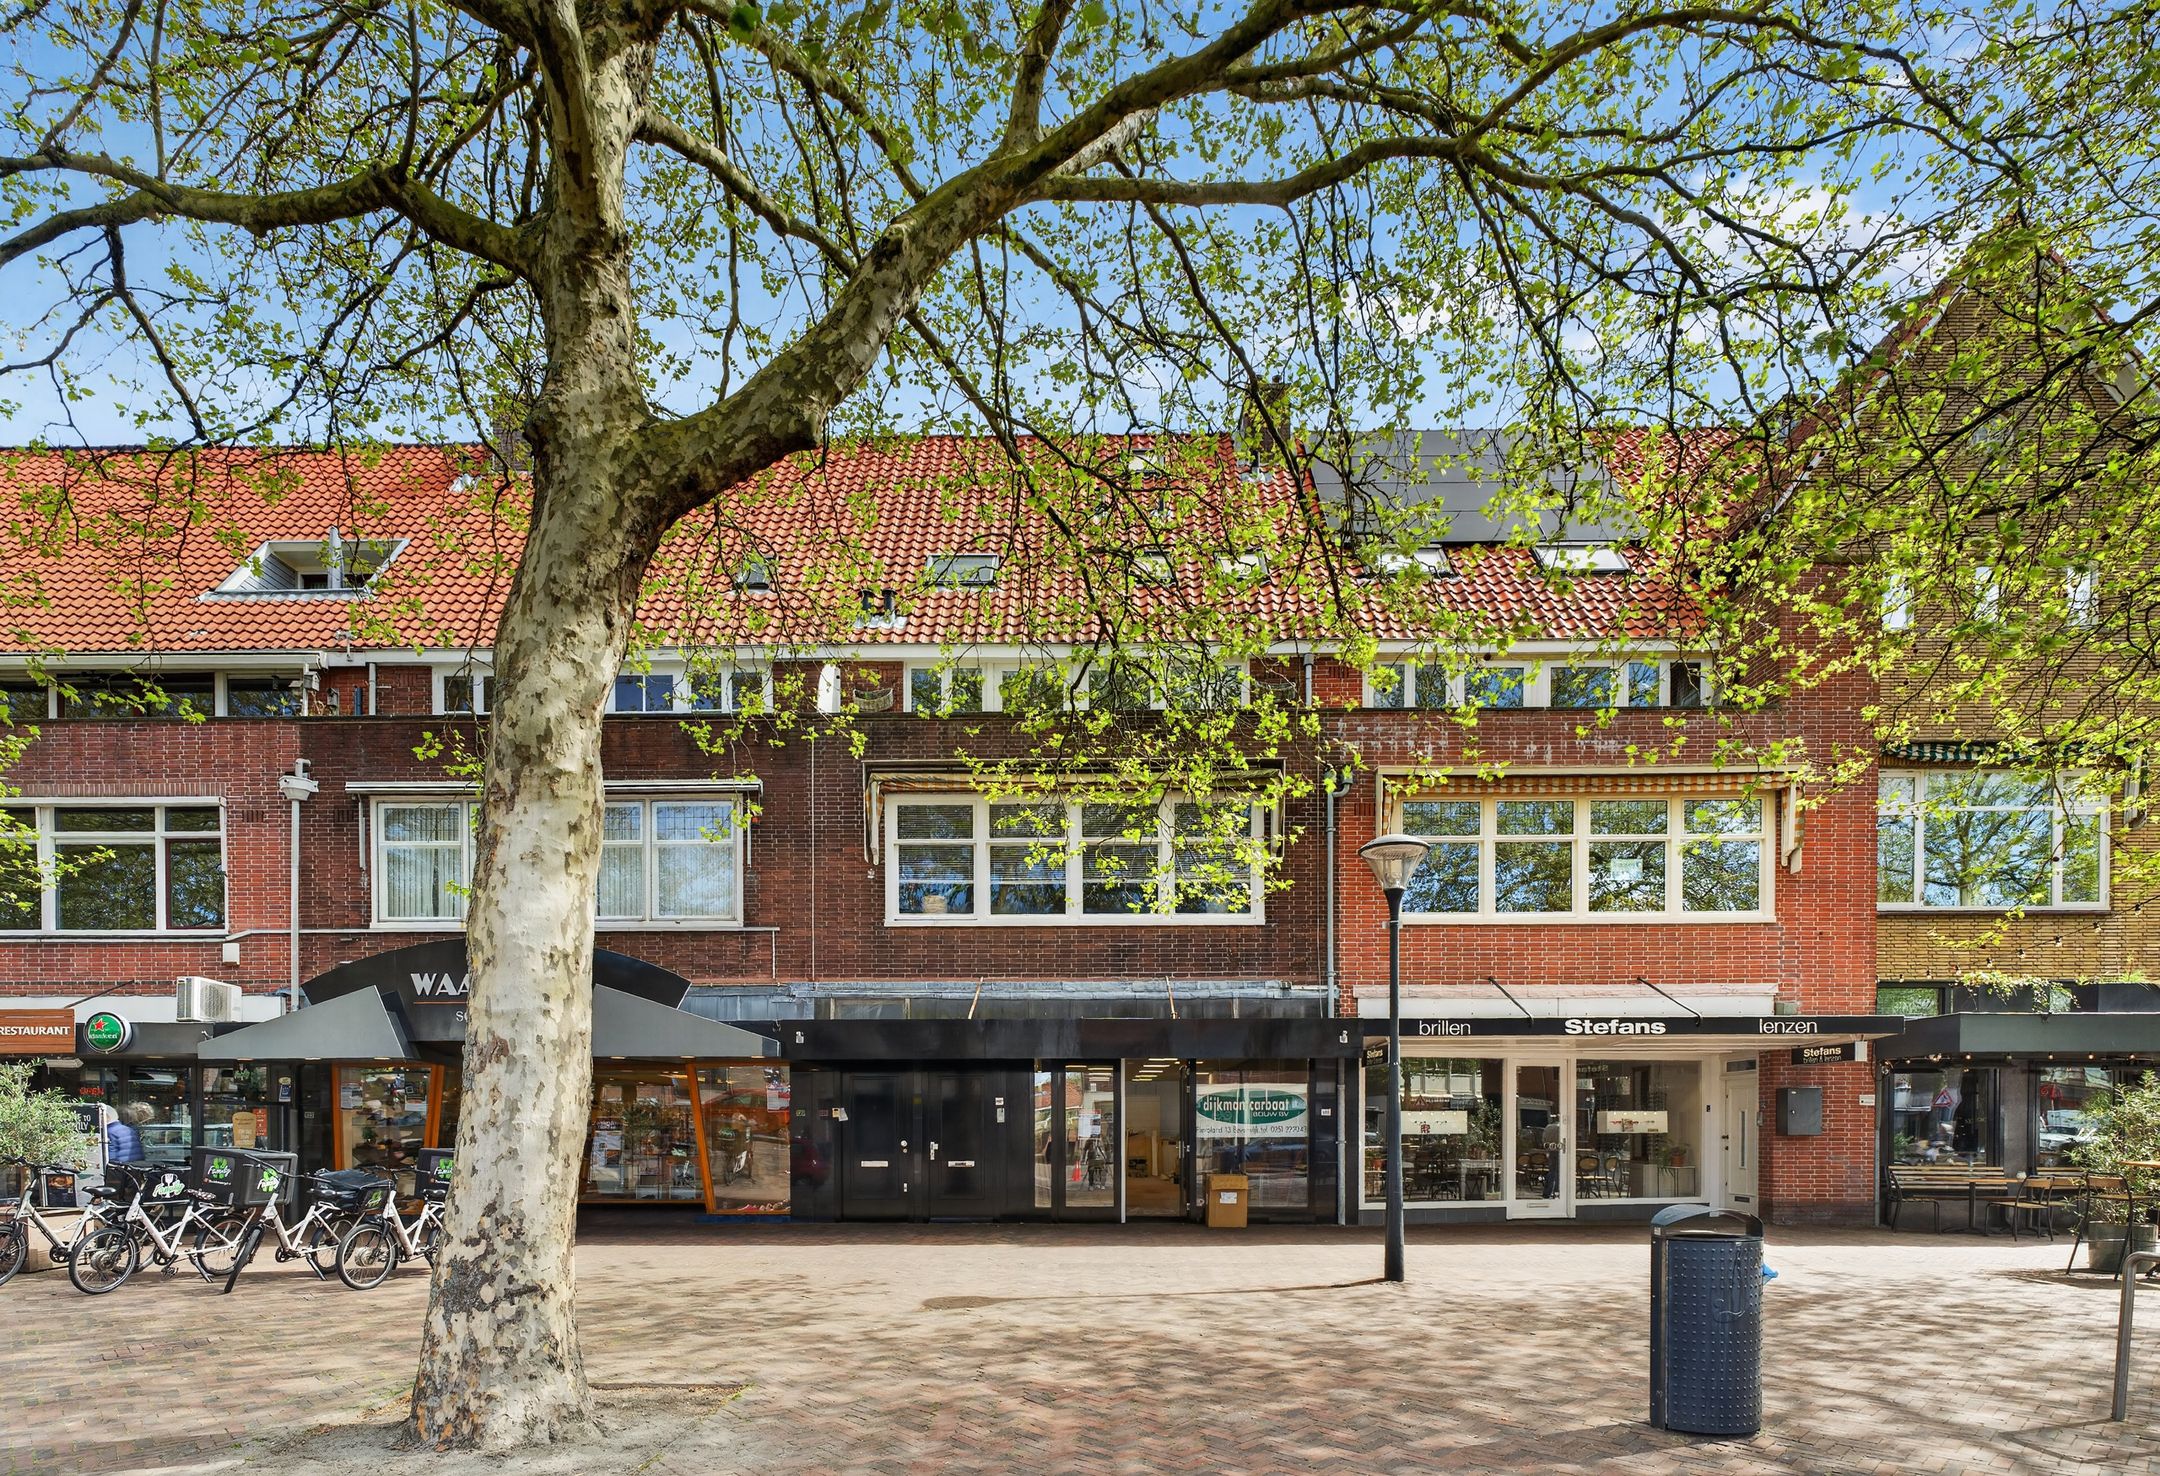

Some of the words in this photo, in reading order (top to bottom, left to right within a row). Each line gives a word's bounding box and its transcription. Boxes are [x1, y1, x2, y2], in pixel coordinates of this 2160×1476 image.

[0, 1026, 71, 1036] RESTAURANT
[1419, 1020, 1472, 1035] brillen
[1564, 1018, 1667, 1035] Stefans
[1759, 1018, 1818, 1034] lenzen
[1803, 1046, 1842, 1058] Stefans
[1203, 1095, 1246, 1116] dijkman
[1249, 1098, 1289, 1111] carbaat
